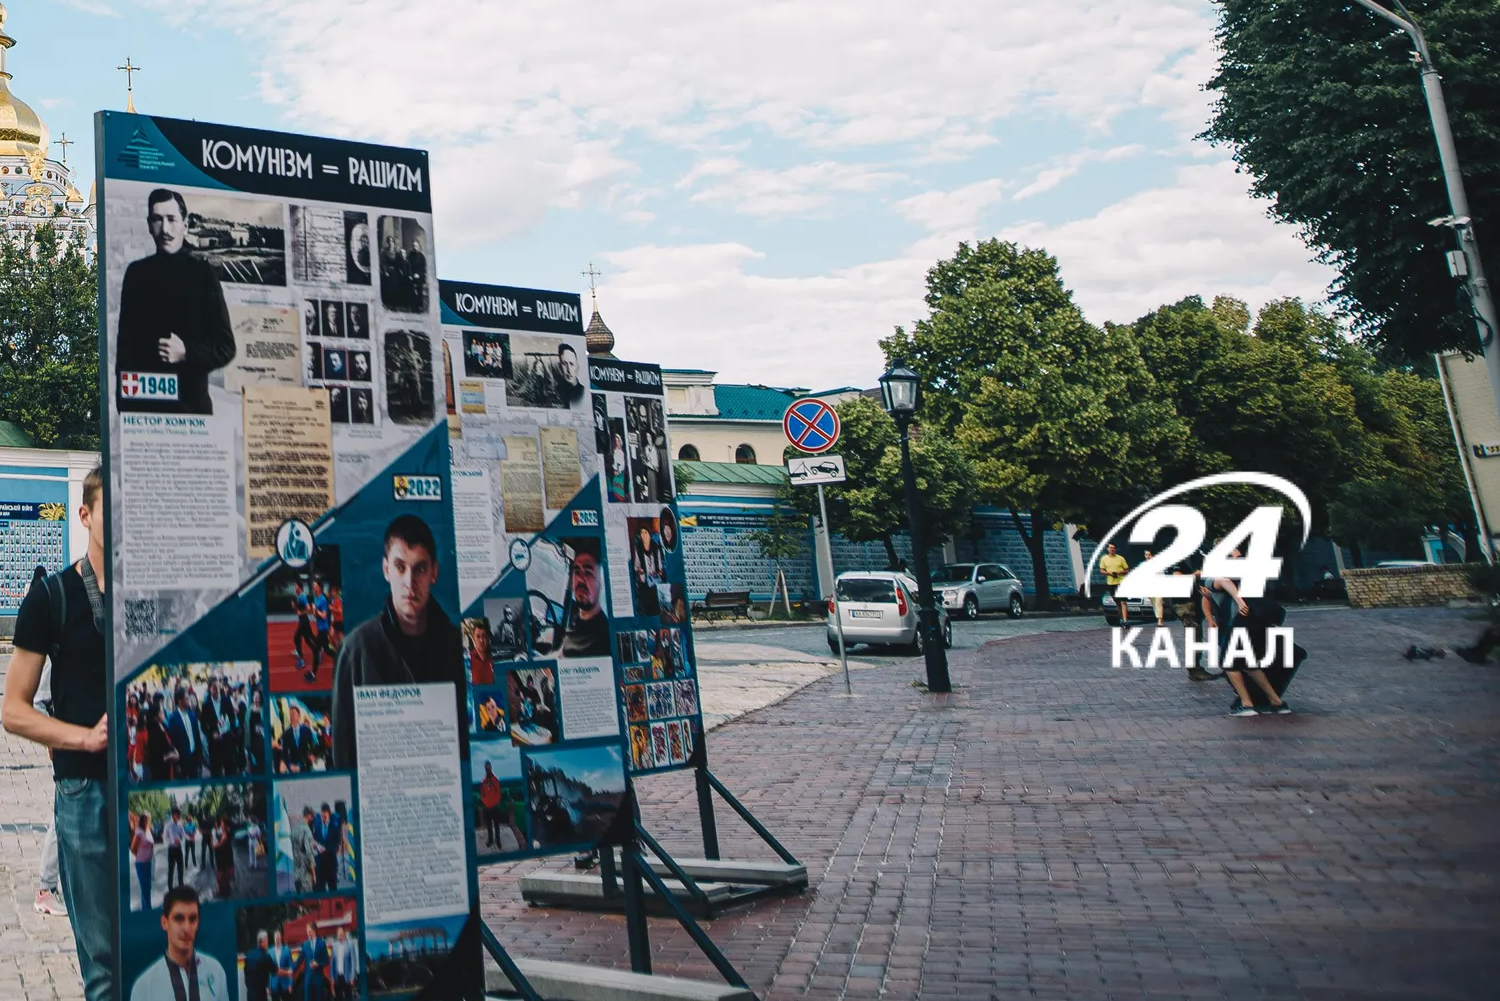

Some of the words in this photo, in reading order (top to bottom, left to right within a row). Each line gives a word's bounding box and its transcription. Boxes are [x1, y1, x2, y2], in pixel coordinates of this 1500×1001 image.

[201, 139, 313, 180] КОМУНІЗМ
[455, 292, 518, 317] КОМУНІЗМ
[589, 365, 626, 383] КОМУНІЗМ
[138, 375, 177, 396] 1948
[123, 415, 163, 426] НЕСТОР
[408, 478, 441, 497] 2022
[578, 510, 599, 526] 2022
[357, 688, 378, 700] ІВАН
[378, 687, 422, 700] ФЕДОРОВ
